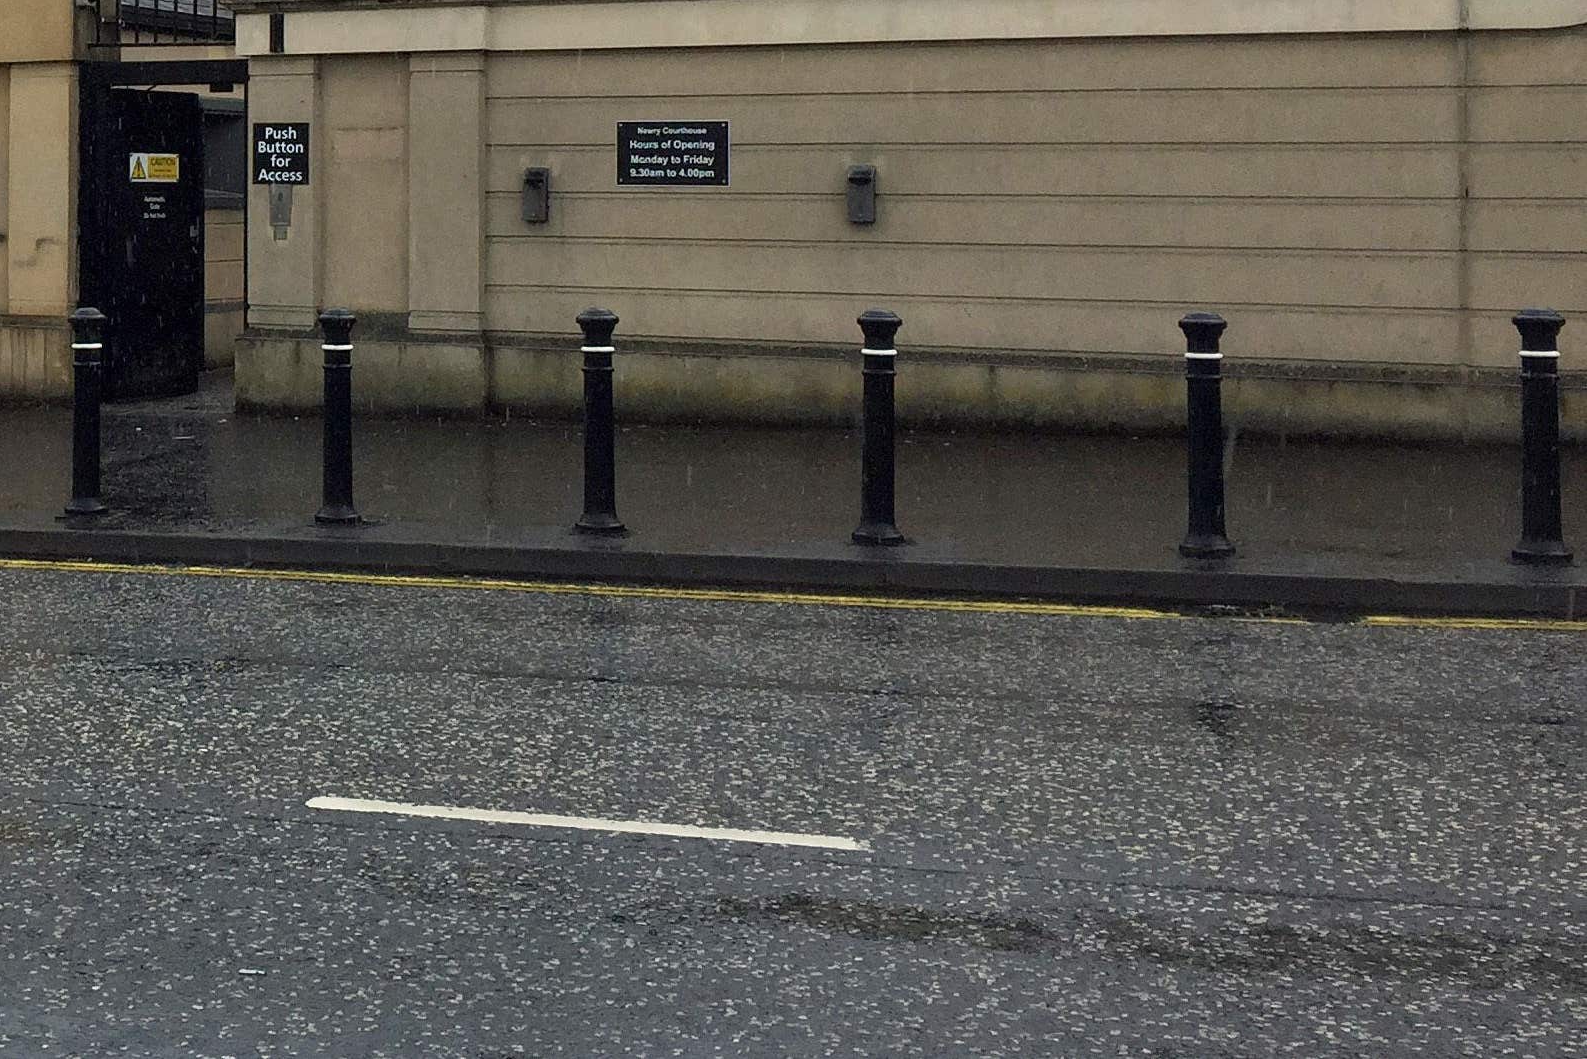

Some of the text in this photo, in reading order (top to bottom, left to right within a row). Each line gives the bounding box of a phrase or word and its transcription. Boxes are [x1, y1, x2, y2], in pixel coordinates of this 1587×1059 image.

[265, 126, 297, 140] Push
[637, 127, 707, 135] Newry Courthouse
[258, 141, 304, 154] Button
[629, 140, 715, 151] Hours of Opening
[270, 154, 291, 167] for
[630, 155, 715, 166] Monday to Friday
[258, 169, 303, 182] Access
[630, 168, 715, 179] 9.30am to 4.00pm
